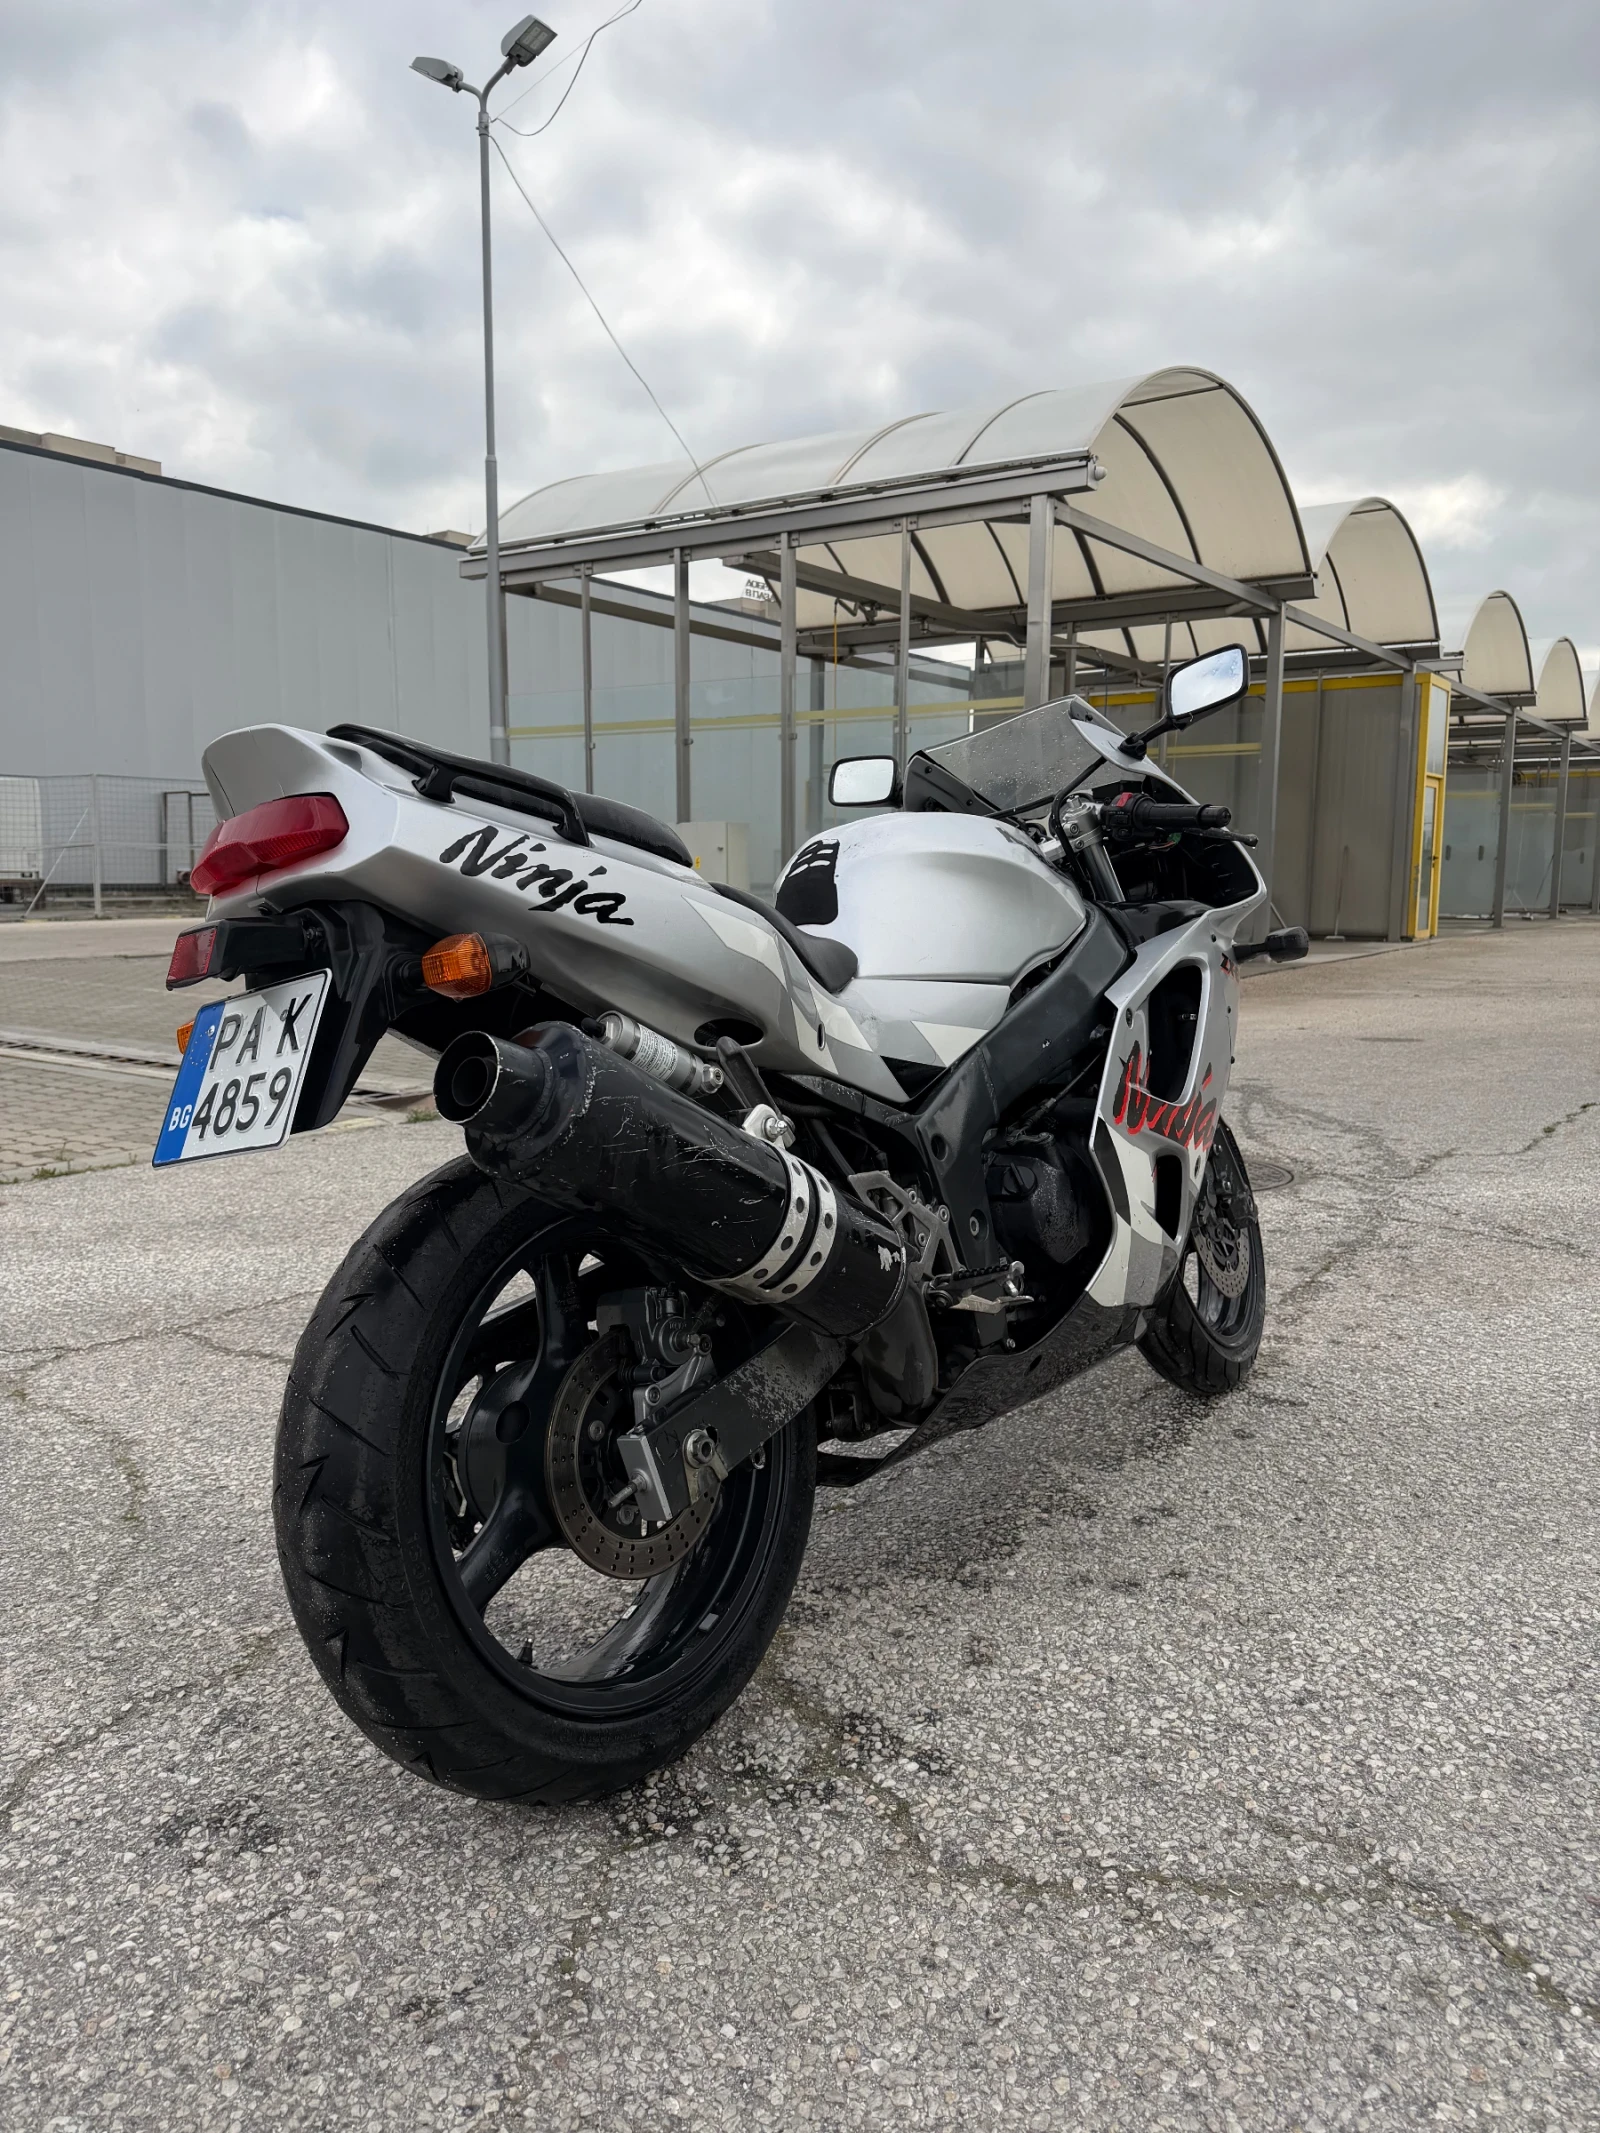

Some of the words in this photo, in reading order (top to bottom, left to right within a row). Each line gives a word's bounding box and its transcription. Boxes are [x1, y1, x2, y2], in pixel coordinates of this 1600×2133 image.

[439, 825, 635, 925] Ninja
[167, 1104, 193, 1132] BG
[191, 1066, 293, 1140] 4859
